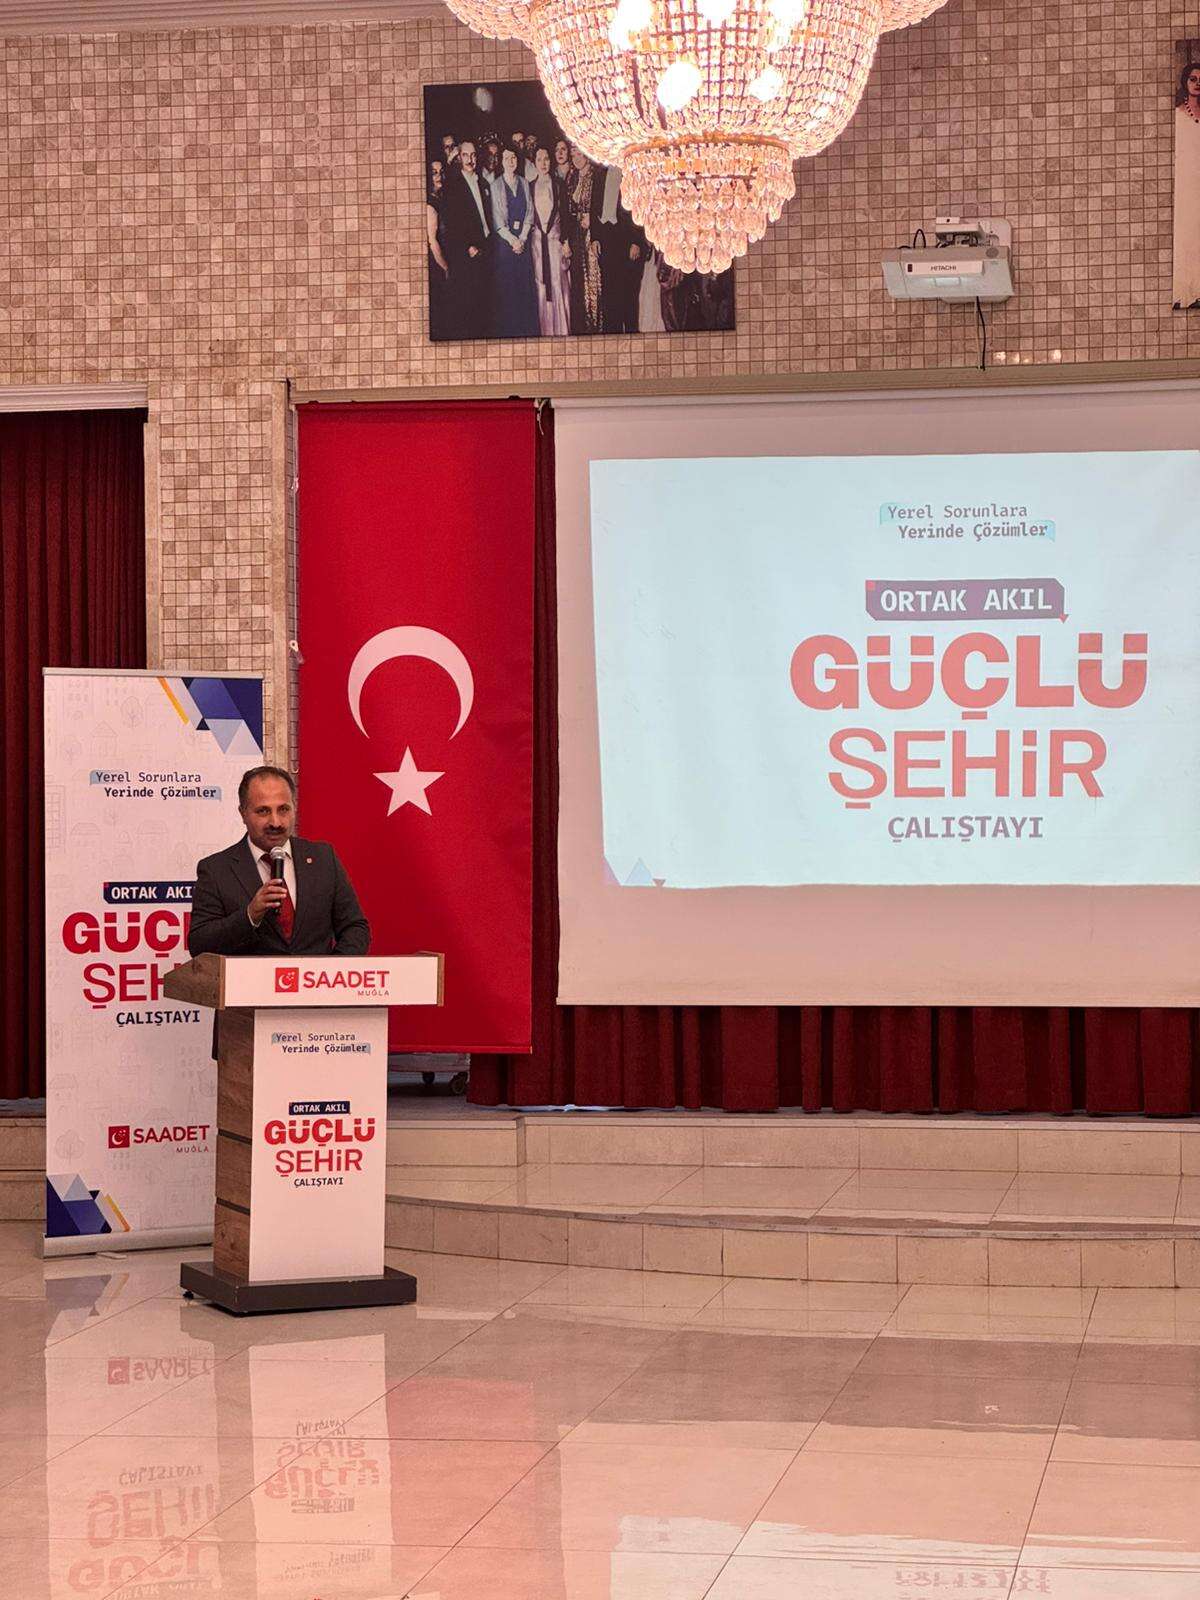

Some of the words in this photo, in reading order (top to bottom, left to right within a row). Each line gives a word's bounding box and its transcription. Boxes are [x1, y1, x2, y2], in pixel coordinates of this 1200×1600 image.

[888, 504, 933, 519] Yerel
[944, 503, 1028, 518] Sorunlara
[899, 523, 964, 539] Yerinde
[973, 522, 1048, 542] Çözümler
[880, 589, 967, 612] ORTAK
[983, 588, 1052, 611] AKIL
[790, 632, 1148, 720] GÜÇLÜ
[95, 771, 131, 783] Yerel
[138, 771, 202, 783] Sorunlara
[104, 785, 154, 798] Yerinde
[160, 785, 217, 800] Çözümler
[887, 815, 1044, 843] ÇALIŞTAYI
[111, 886, 157, 900] ORTAK
[166, 886, 194, 899] AKI
[303, 970, 390, 989] SAADET
[357, 989, 390, 997] MUĞLA
[116, 1010, 200, 1028] ÇALIŞTAYI
[275, 1033, 302, 1042] Yerel
[308, 1032, 355, 1042] Sorunlara
[282, 1044, 320, 1053] Yerinde
[324, 1043, 367, 1055] Çözümler
[293, 1104, 320, 1113] ORTAK
[325, 1103, 347, 1112] AKIL
[133, 1125, 210, 1144] SAADET
[264, 1118, 375, 1147] GÜÇLÜ
[176, 1145, 209, 1154] MUĞLA
[294, 1177, 343, 1188] ÇALIŞTAYI
